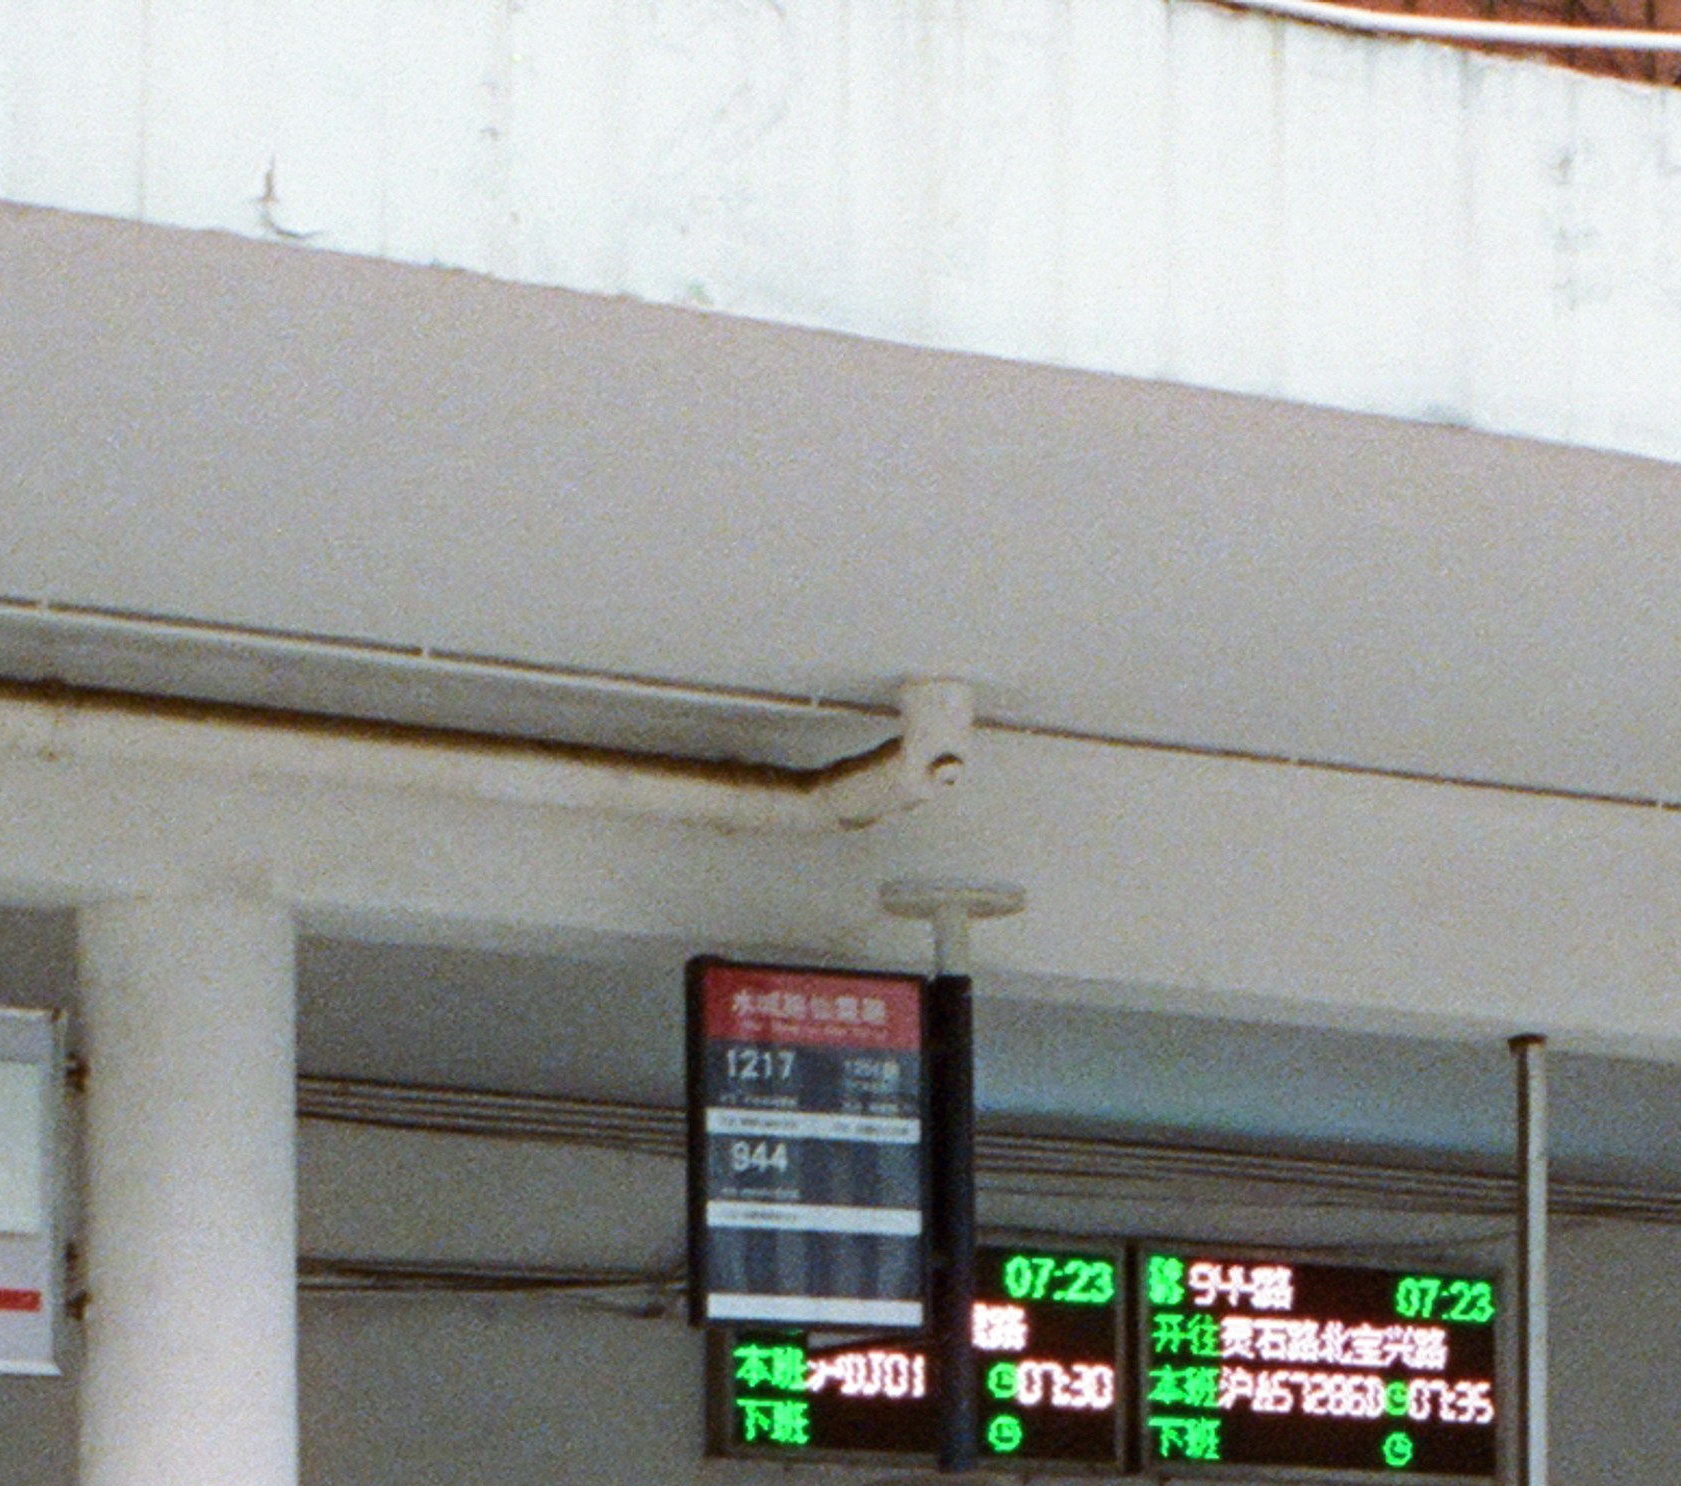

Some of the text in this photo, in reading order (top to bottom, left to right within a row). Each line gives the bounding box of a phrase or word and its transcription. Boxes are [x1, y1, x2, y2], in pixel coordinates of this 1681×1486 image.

[727, 1049, 797, 1080] 1217
[730, 1140, 789, 1173] 944
[1003, 1255, 1115, 1303] 07:23
[1395, 1276, 1496, 1322] 07:23
[1017, 1360, 1115, 1410] 07:30
[1406, 1377, 1496, 1425] 07:35
